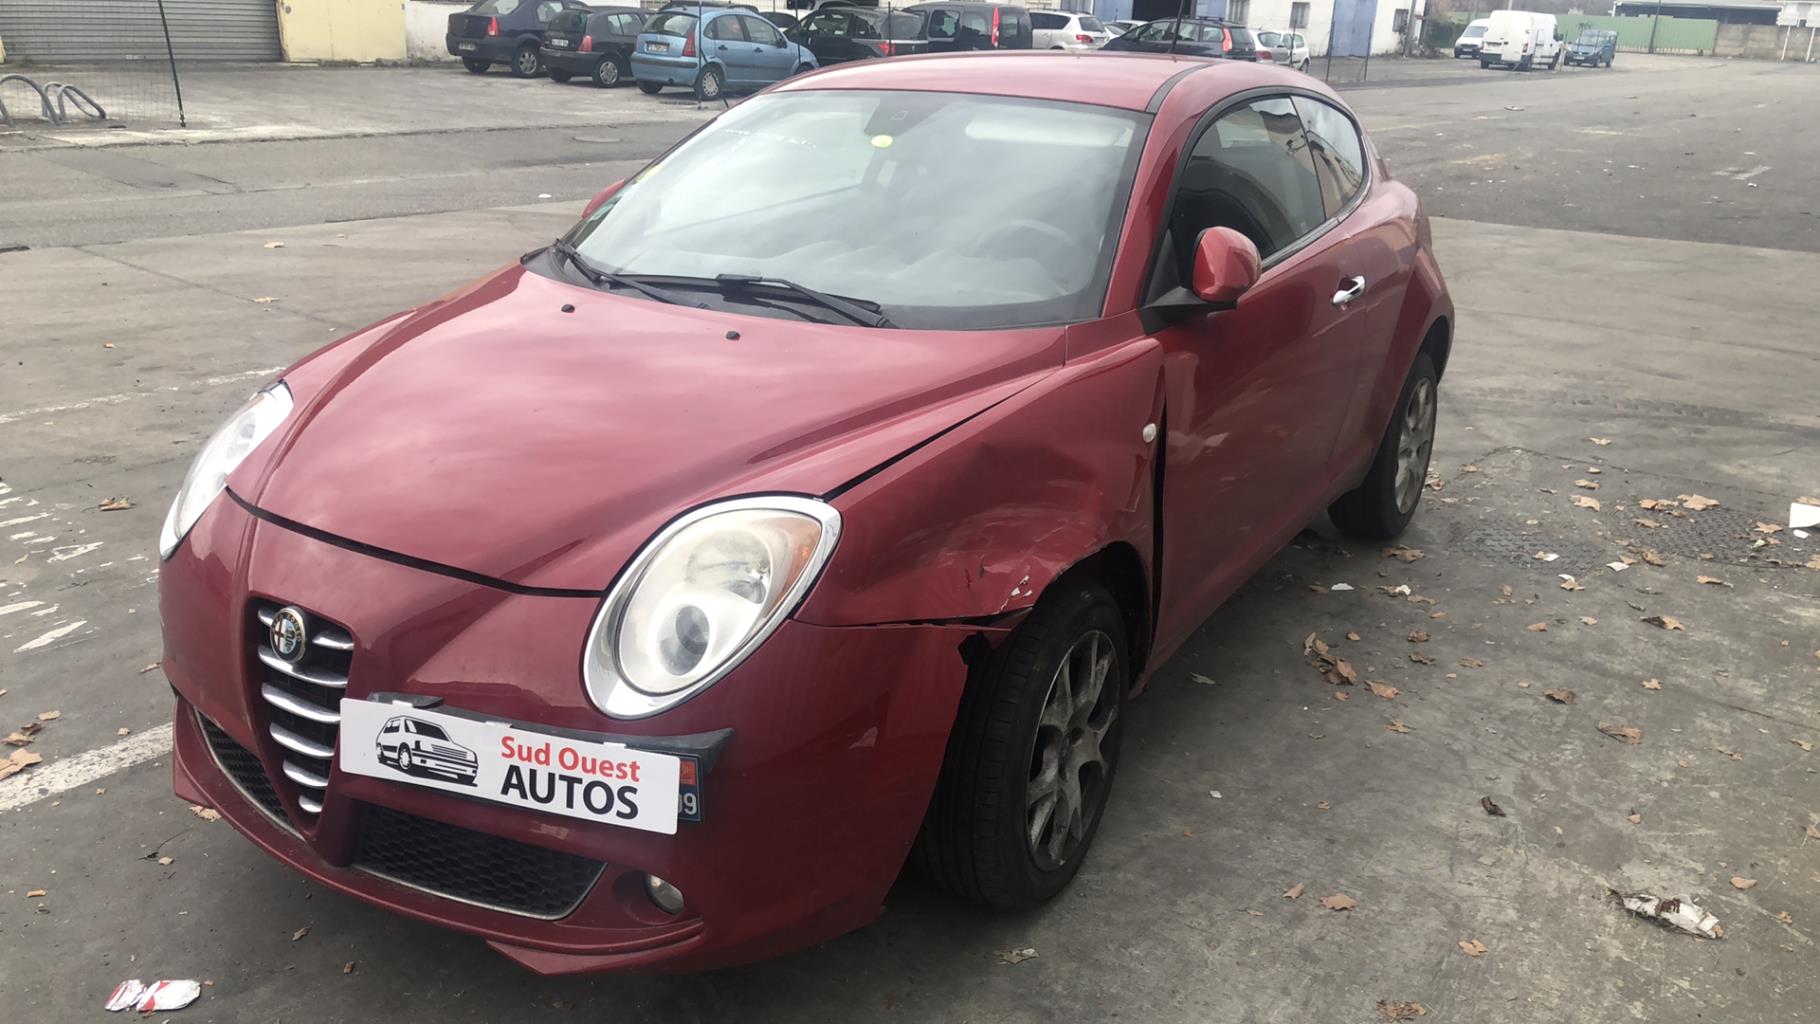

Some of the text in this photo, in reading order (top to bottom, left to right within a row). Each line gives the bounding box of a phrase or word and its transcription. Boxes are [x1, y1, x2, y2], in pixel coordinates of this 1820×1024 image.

[501, 735, 640, 783] Sud Ouest
[501, 764, 639, 820] AUTOS
